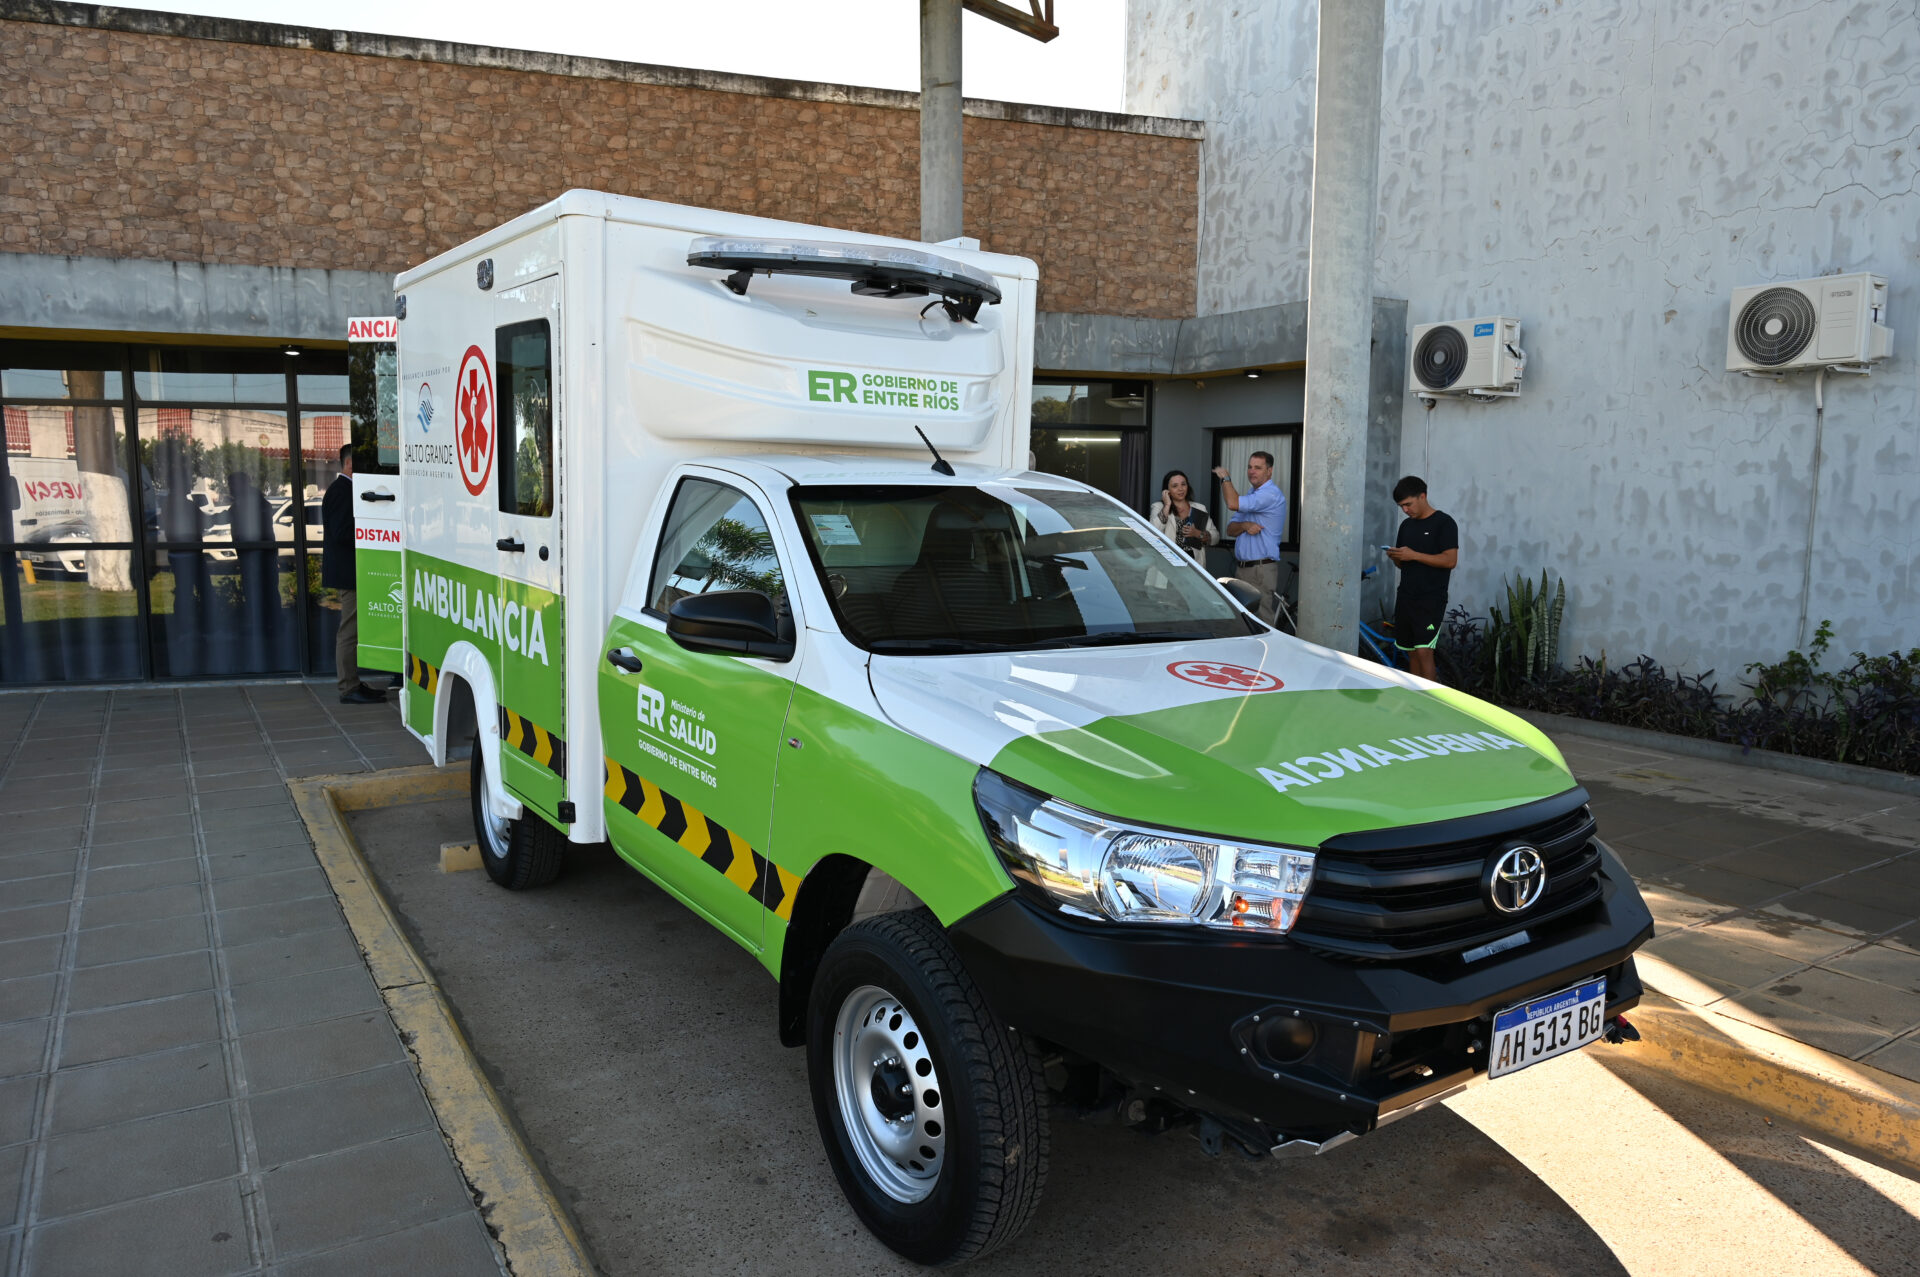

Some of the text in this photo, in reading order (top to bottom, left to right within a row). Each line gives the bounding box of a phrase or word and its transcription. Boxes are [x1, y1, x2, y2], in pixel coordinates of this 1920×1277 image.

[808, 370, 858, 404] ER
[862, 373, 958, 394] GOBIERNO DE
[863, 389, 960, 411] ENTRE RÍOS
[404, 444, 453, 465] SALTO GRANDE
[355, 528, 400, 543] DISTAN
[368, 601, 395, 613] SALTO
[413, 569, 549, 666] AMBULANCIA
[637, 683, 665, 733] ER
[671, 699, 706, 722] Ministerio de
[669, 714, 717, 756] SALUD
[638, 739, 717, 788] GOBIERNO DE ENTRE RÍOS
[1553, 996, 1579, 1012] ARGENTINA
[1497, 1001, 1602, 1070] AH 513 BG
